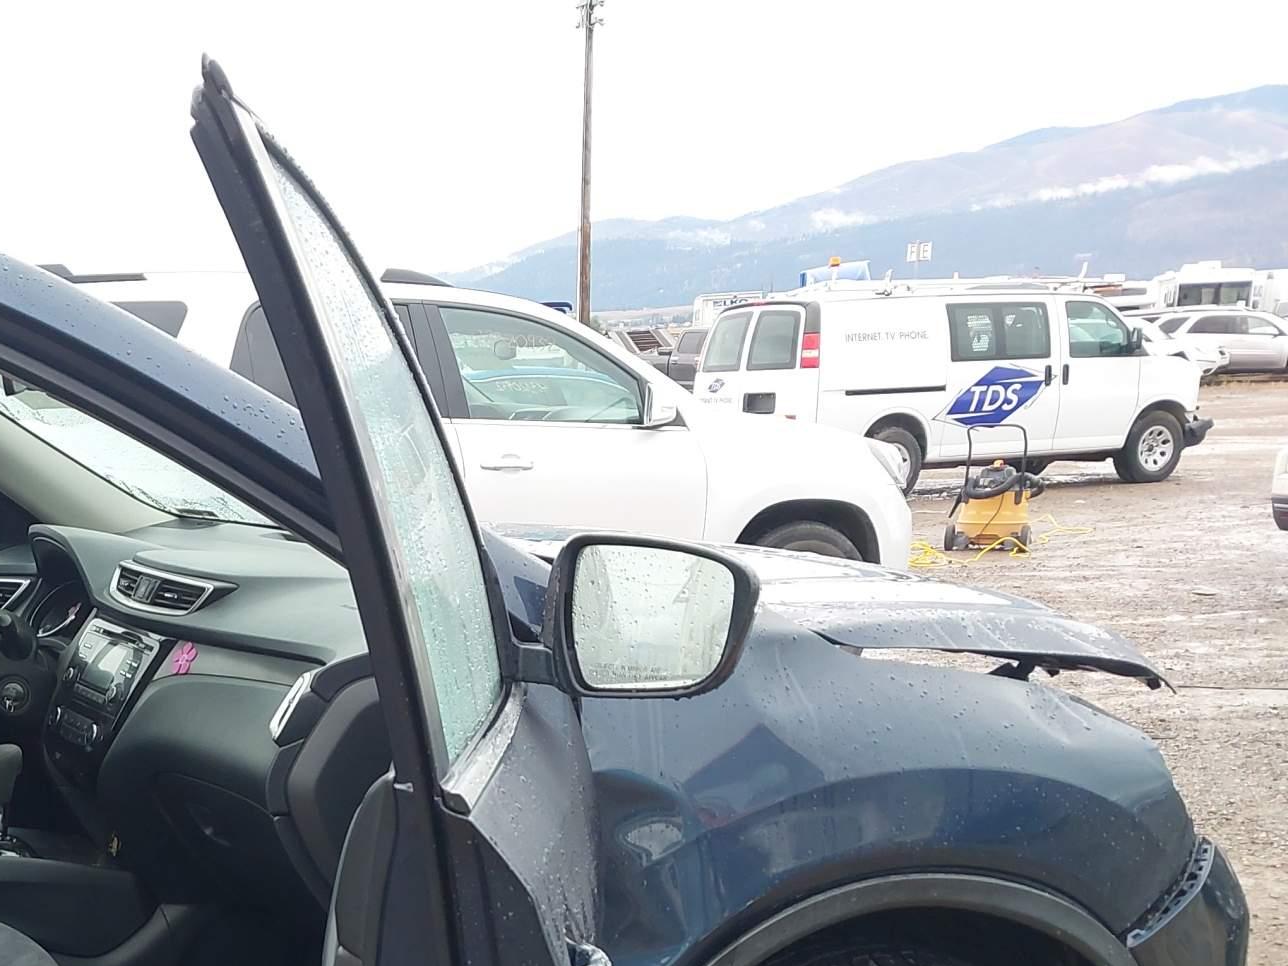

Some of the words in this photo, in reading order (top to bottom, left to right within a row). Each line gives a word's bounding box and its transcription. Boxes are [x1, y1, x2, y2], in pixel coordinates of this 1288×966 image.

[844, 331, 881, 343] INTERNET
[885, 331, 896, 341] TV
[899, 330, 929, 341] PHONE
[968, 383, 1022, 412] TDS
